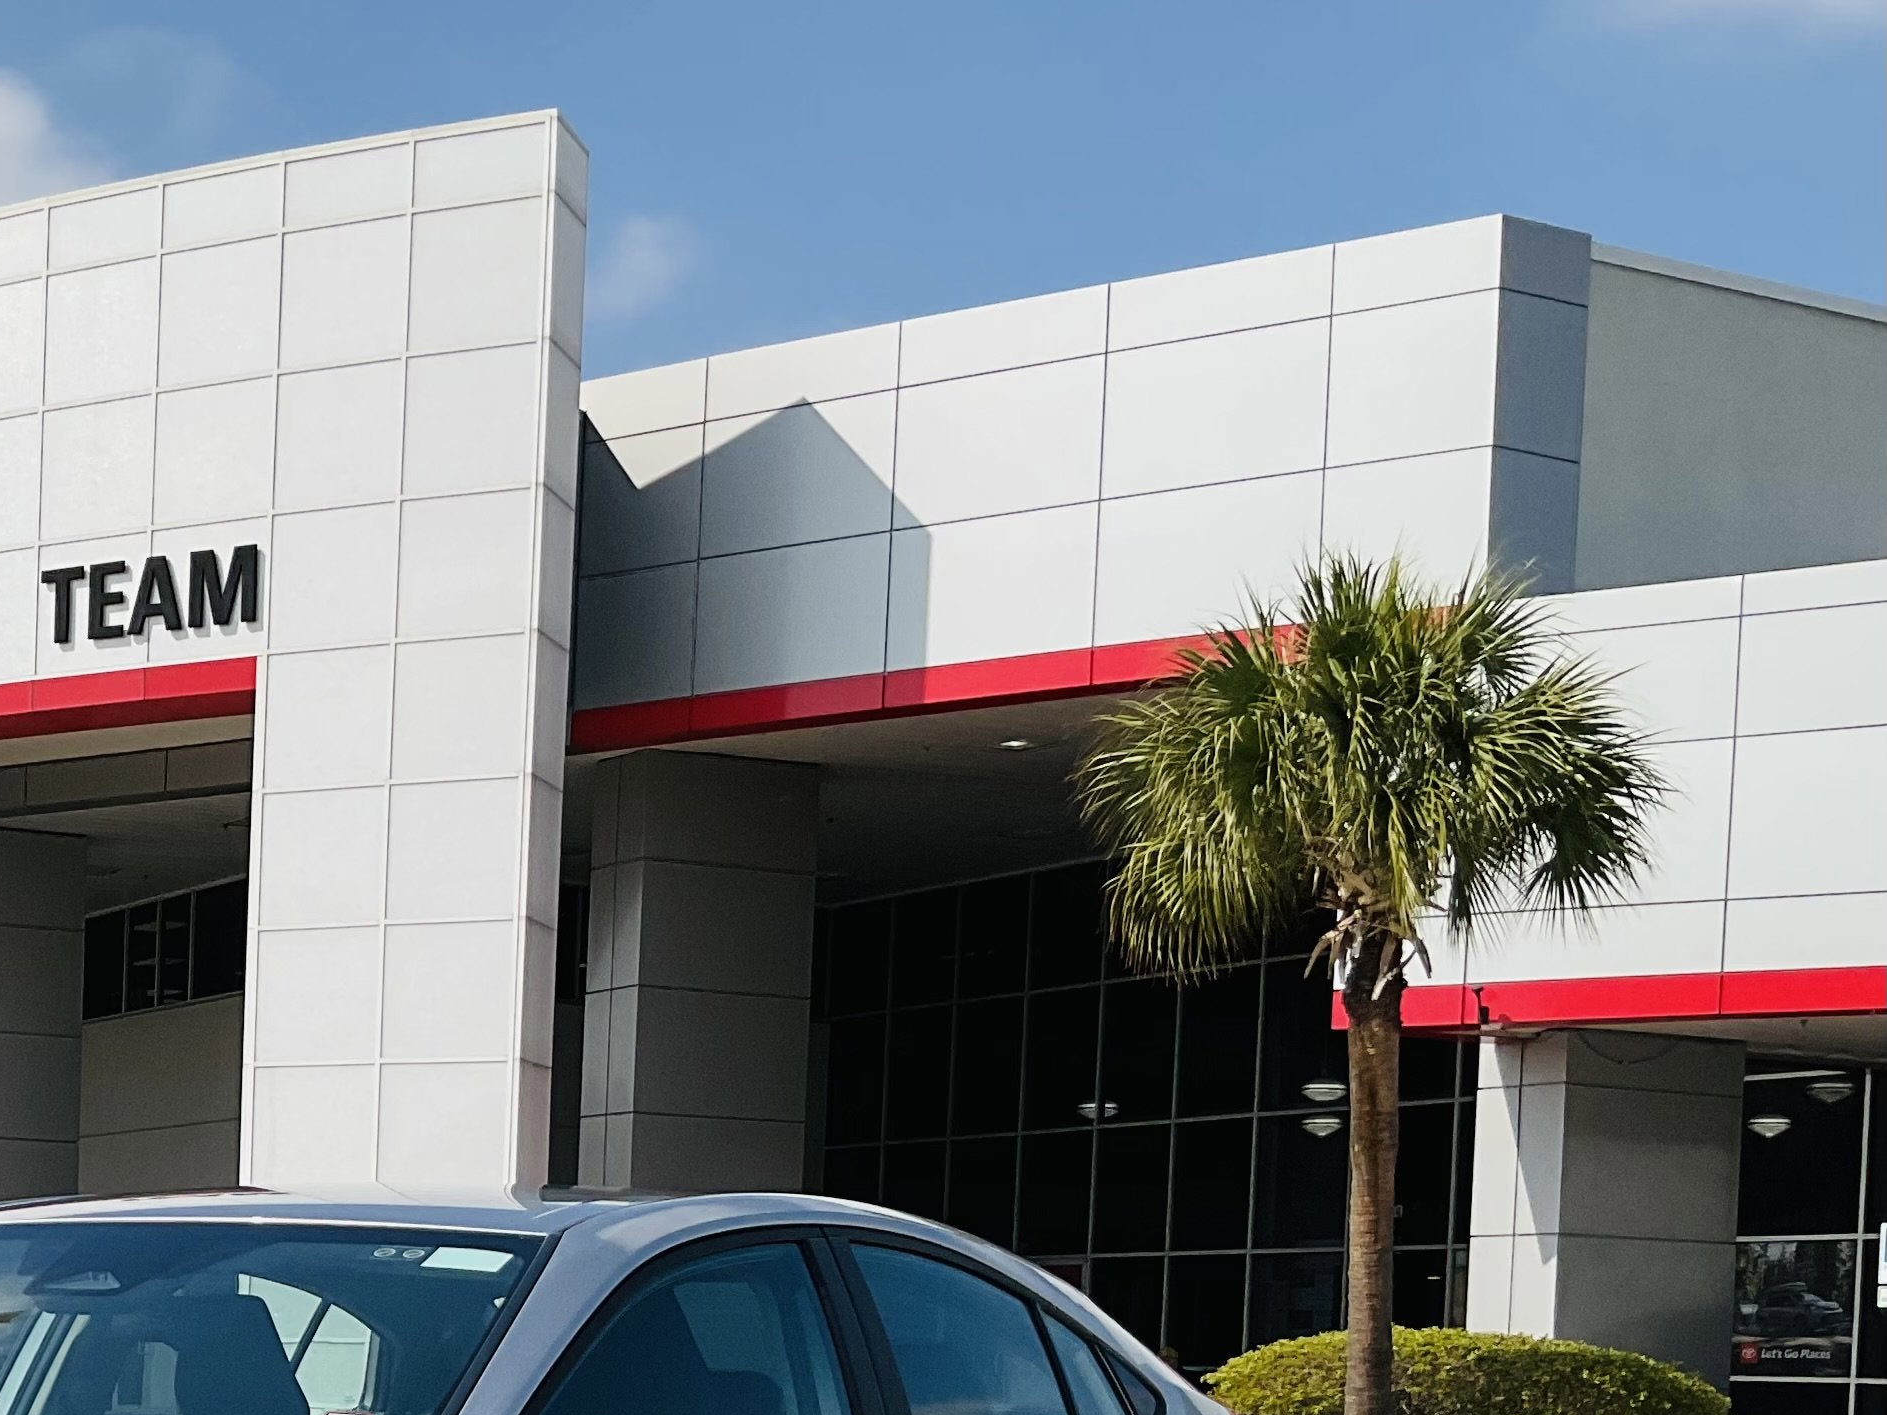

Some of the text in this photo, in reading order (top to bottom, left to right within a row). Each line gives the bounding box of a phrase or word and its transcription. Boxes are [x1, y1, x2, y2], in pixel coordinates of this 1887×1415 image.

[41, 543, 259, 644] TEAM
[1784, 1348, 1800, 1359] Go
[1800, 1348, 1832, 1360] Places
